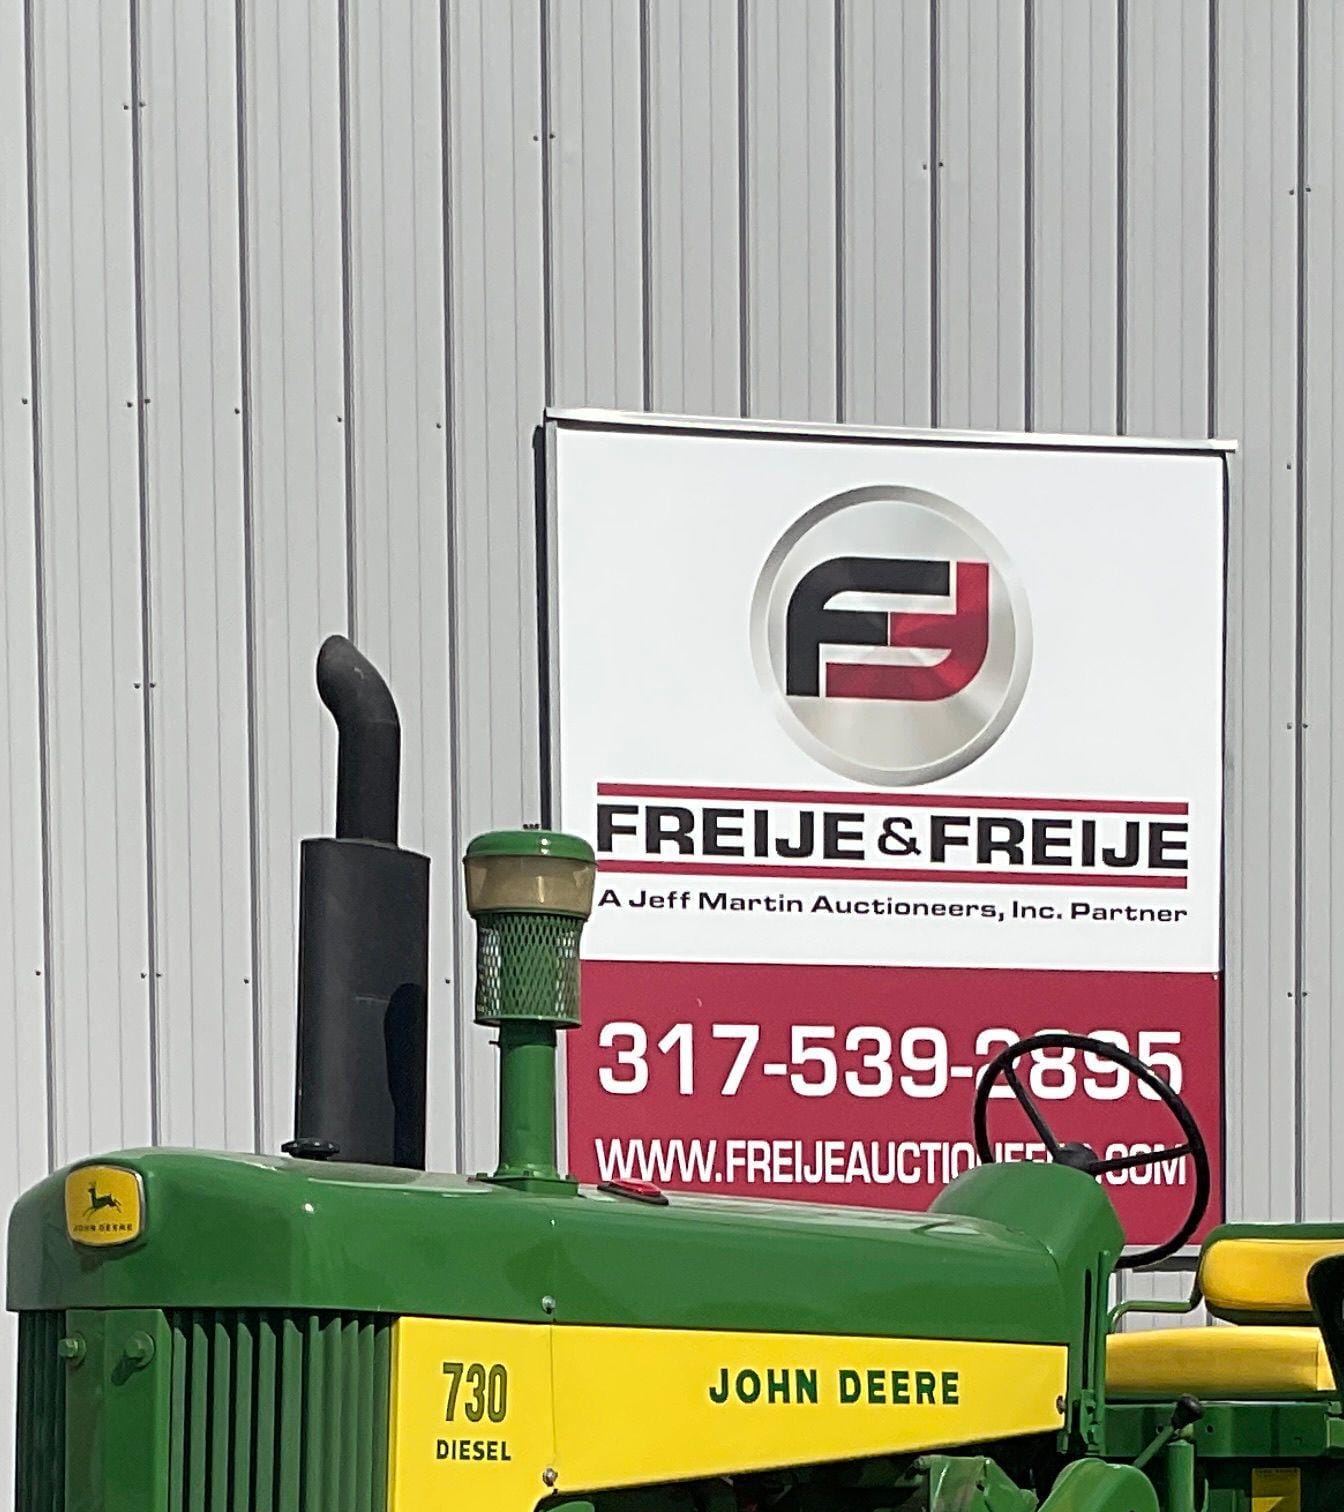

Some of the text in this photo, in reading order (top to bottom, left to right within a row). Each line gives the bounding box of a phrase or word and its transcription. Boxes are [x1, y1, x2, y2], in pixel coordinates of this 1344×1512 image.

[597, 804, 1189, 870] FREIJE & FREIJE
[598, 889, 1188, 922] A Jeff Martin Auctioneers, Inc. Partner
[598, 1021, 1183, 1101] 317-539-2895
[595, 1138, 1186, 1185] WWW.FREIJEAUCTIOEE.COM
[442, 1363, 508, 1422] 730
[709, 1368, 959, 1405] JOHN DEERE
[436, 1439, 511, 1461] DIESEL
